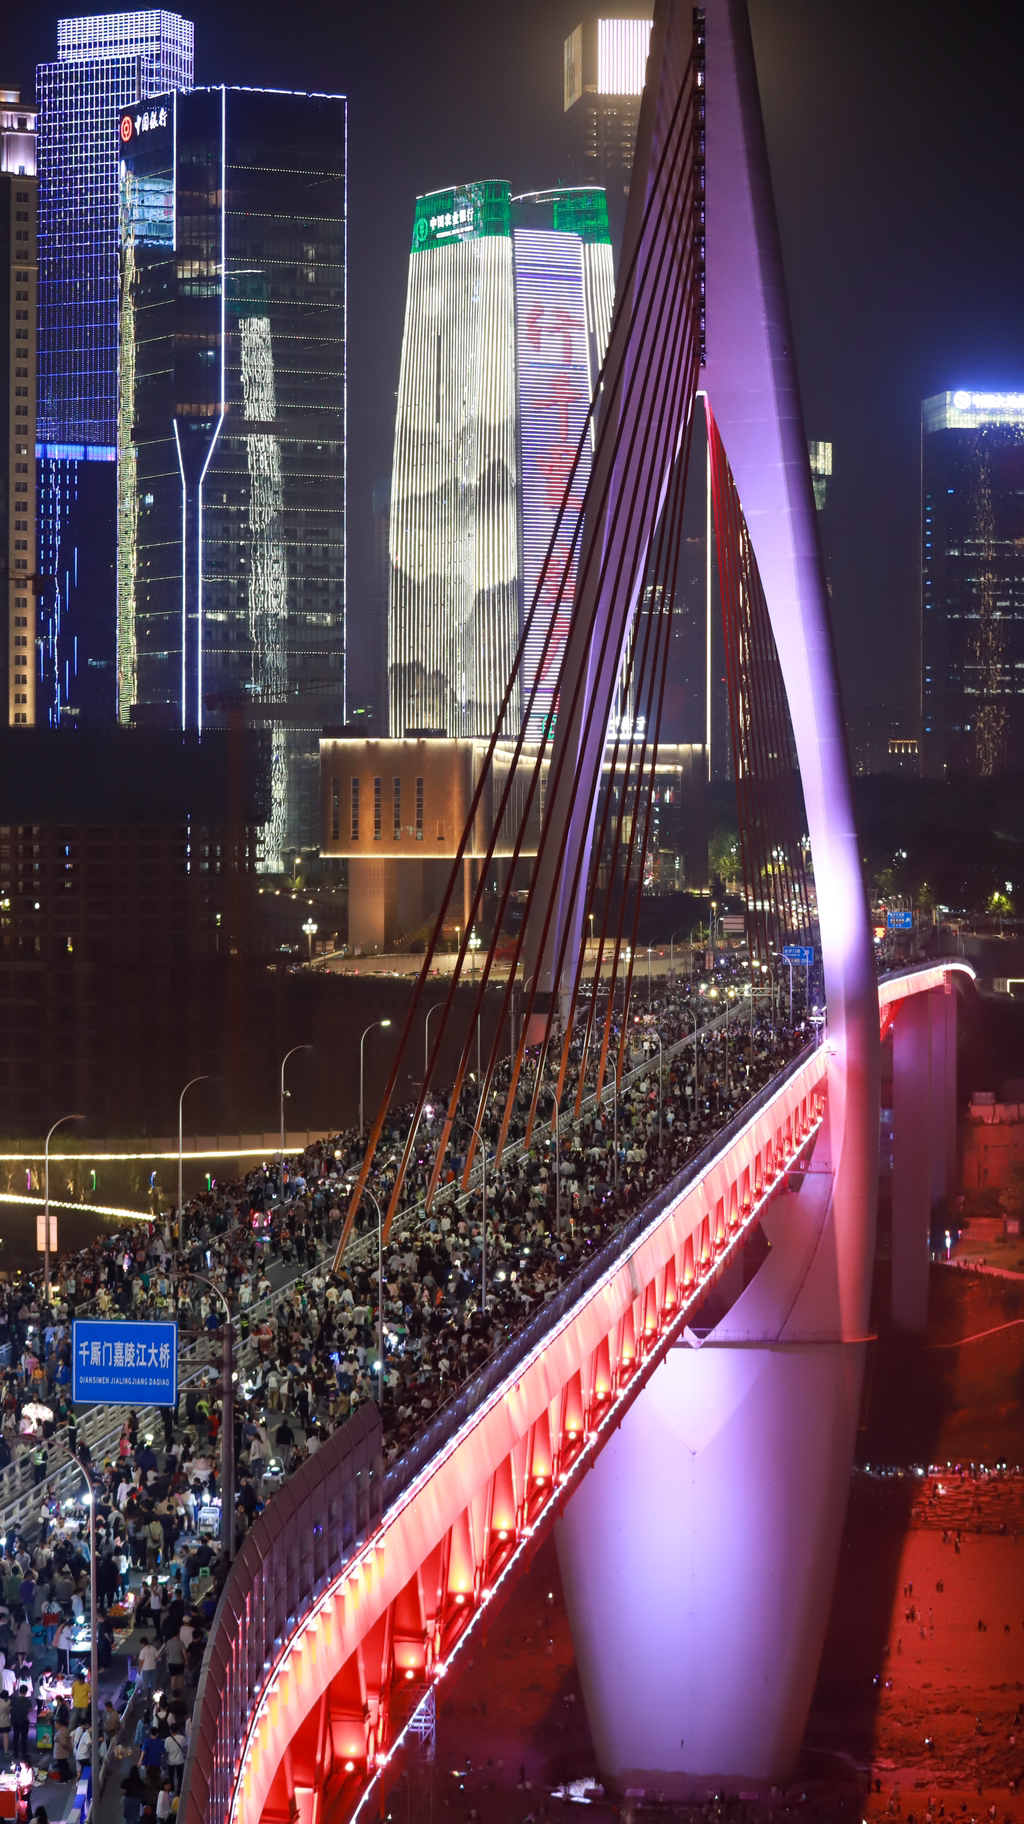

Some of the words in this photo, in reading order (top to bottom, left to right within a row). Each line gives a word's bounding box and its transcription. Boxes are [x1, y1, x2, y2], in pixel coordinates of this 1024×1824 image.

[134, 107, 168, 136] 中国银行
[429, 208, 474, 230] 中国农业银行
[78, 1341, 170, 1368] 千厮门嘉陵江大桥
[79, 1376, 109, 1384] QIANSIMEN
[110, 1377, 148, 1385] JIALINGJIANG
[149, 1378, 170, 1386] DAQIAO
